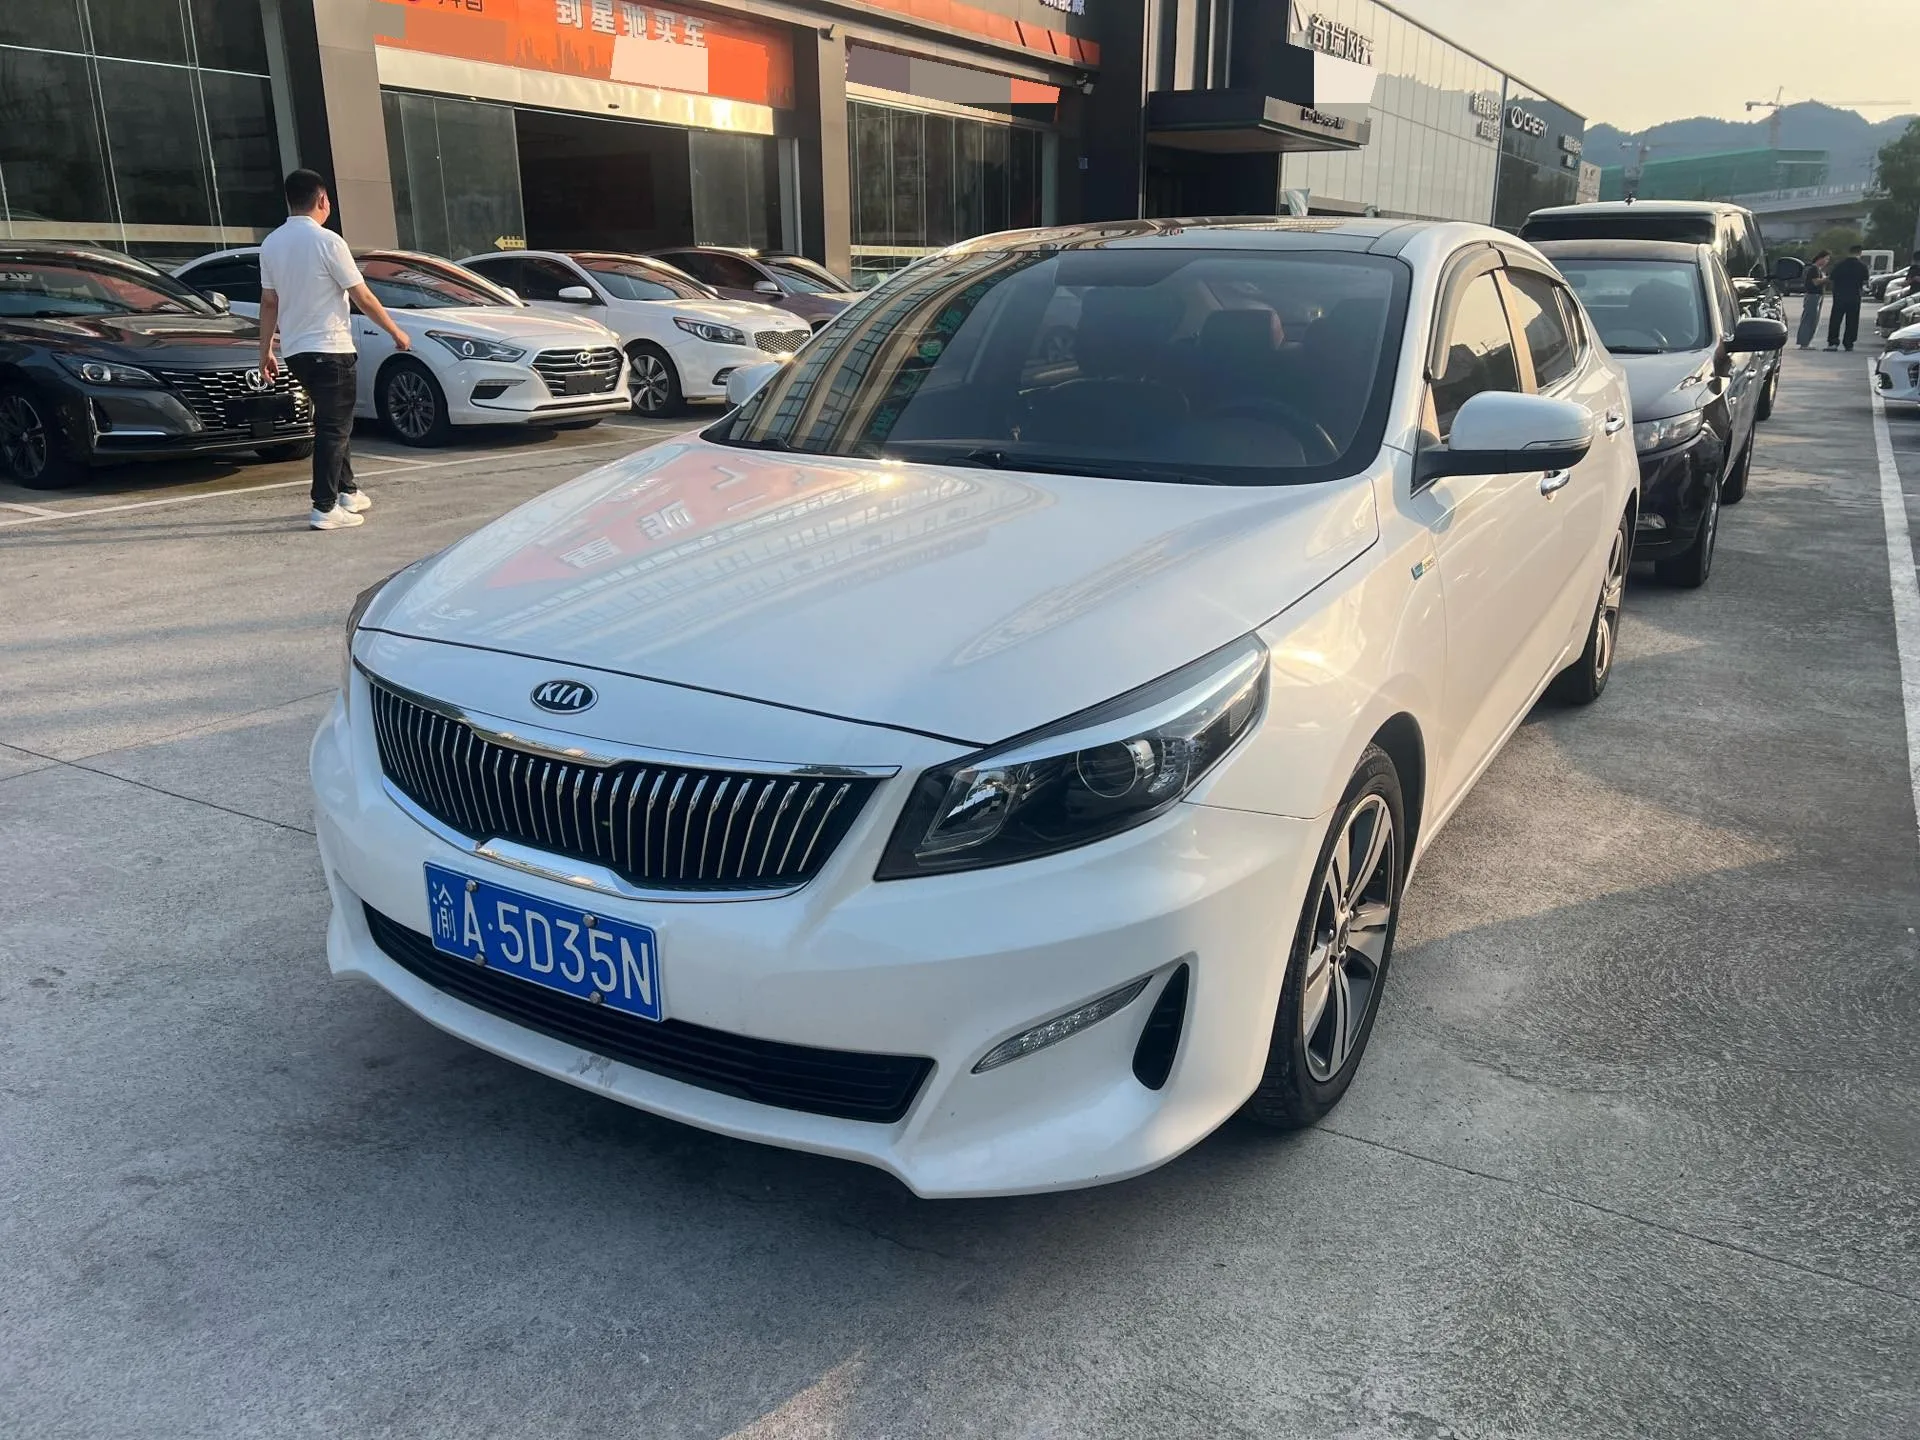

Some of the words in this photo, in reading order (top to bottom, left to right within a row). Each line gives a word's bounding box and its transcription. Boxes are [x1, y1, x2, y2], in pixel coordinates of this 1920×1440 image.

[556, 0, 705, 48] 到星驰买车
[1523, 112, 1549, 138] CHERY
[537, 682, 585, 708] KIA
